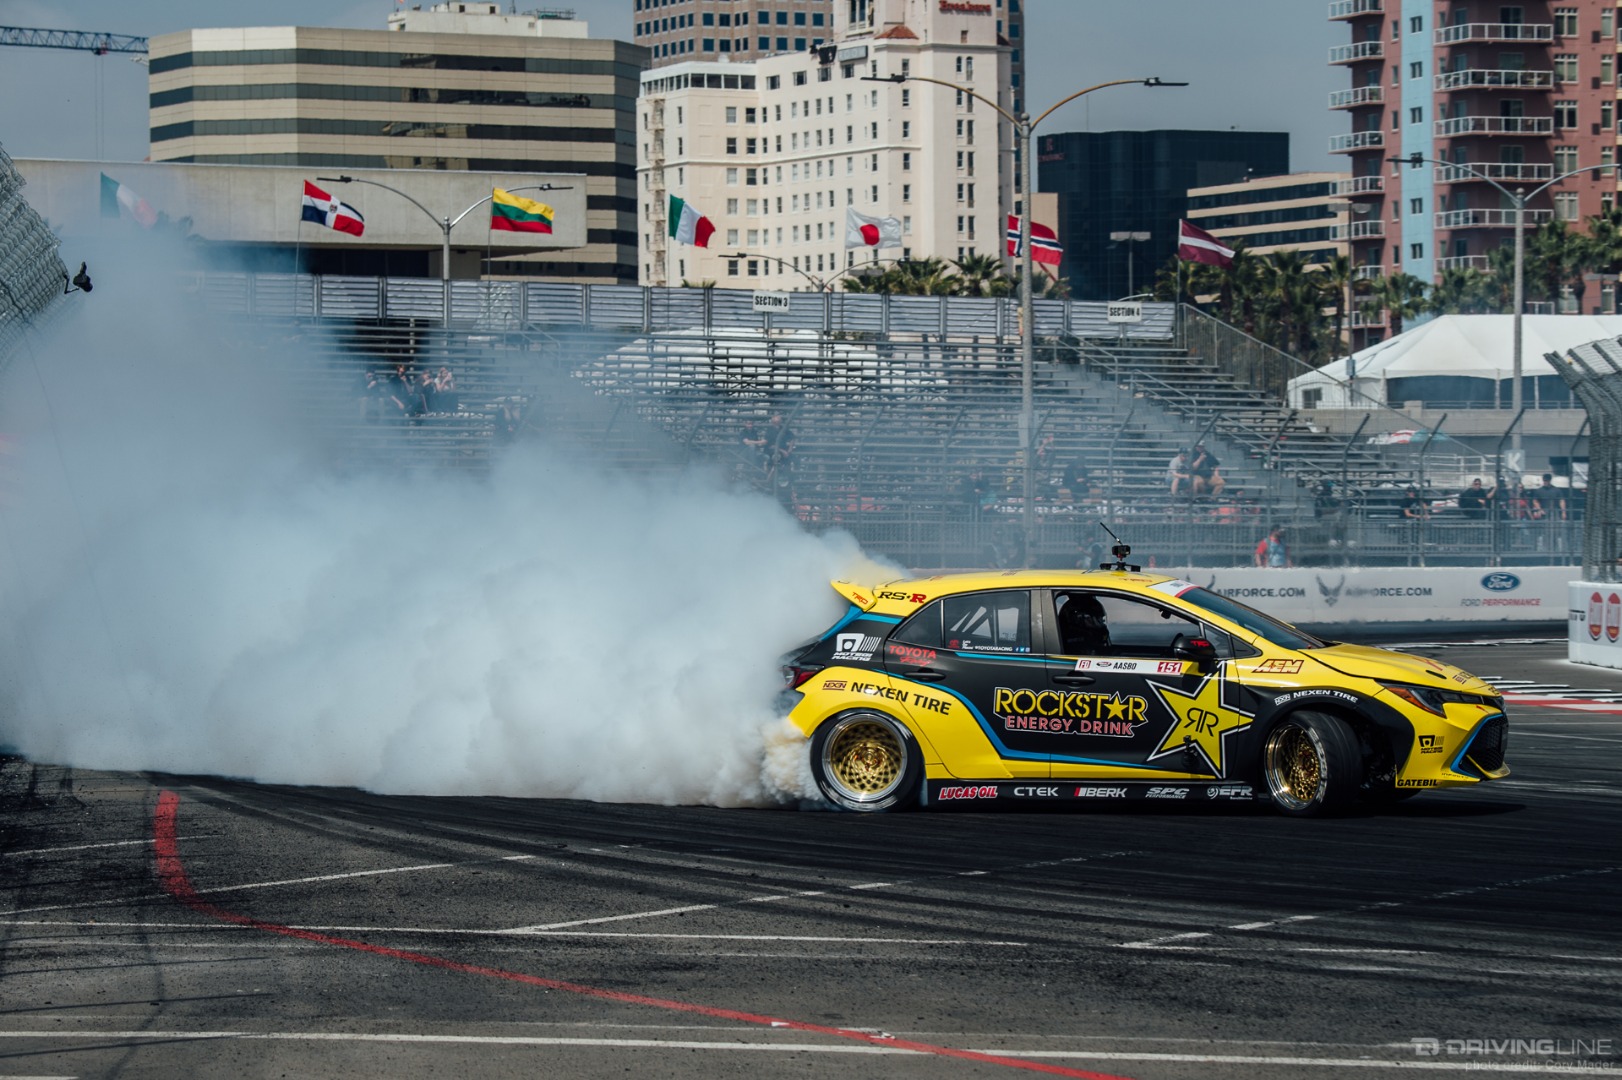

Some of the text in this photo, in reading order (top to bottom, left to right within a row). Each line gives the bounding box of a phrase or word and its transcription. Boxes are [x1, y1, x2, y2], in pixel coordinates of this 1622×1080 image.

[754, 295, 788, 307] SECTION 3
[1109, 307, 1135, 316] SECTION
[1508, 452, 1521, 471] K
[1487, 575, 1514, 588] Ford
[852, 591, 869, 605] TRD
[1460, 598, 1541, 607] FORD PERFORMANCE
[889, 645, 937, 659] TOYOTA
[1112, 661, 1138, 671] AASBO
[1159, 662, 1181, 673] 151
[1252, 659, 1304, 674] AEM
[850, 682, 952, 715] NEXEN TIRE
[1293, 689, 1358, 703] NEXEN TIRE
[1006, 715, 1133, 735] ENERGY DRINK
[1397, 779, 1439, 787] GATEBIL
[939, 786, 998, 800] LUCAS OIL
[1013, 786, 1059, 797] CTEK
[1086, 787, 1128, 797] BERK
[1147, 787, 1190, 795] SPC
[1219, 785, 1253, 796] EFR
